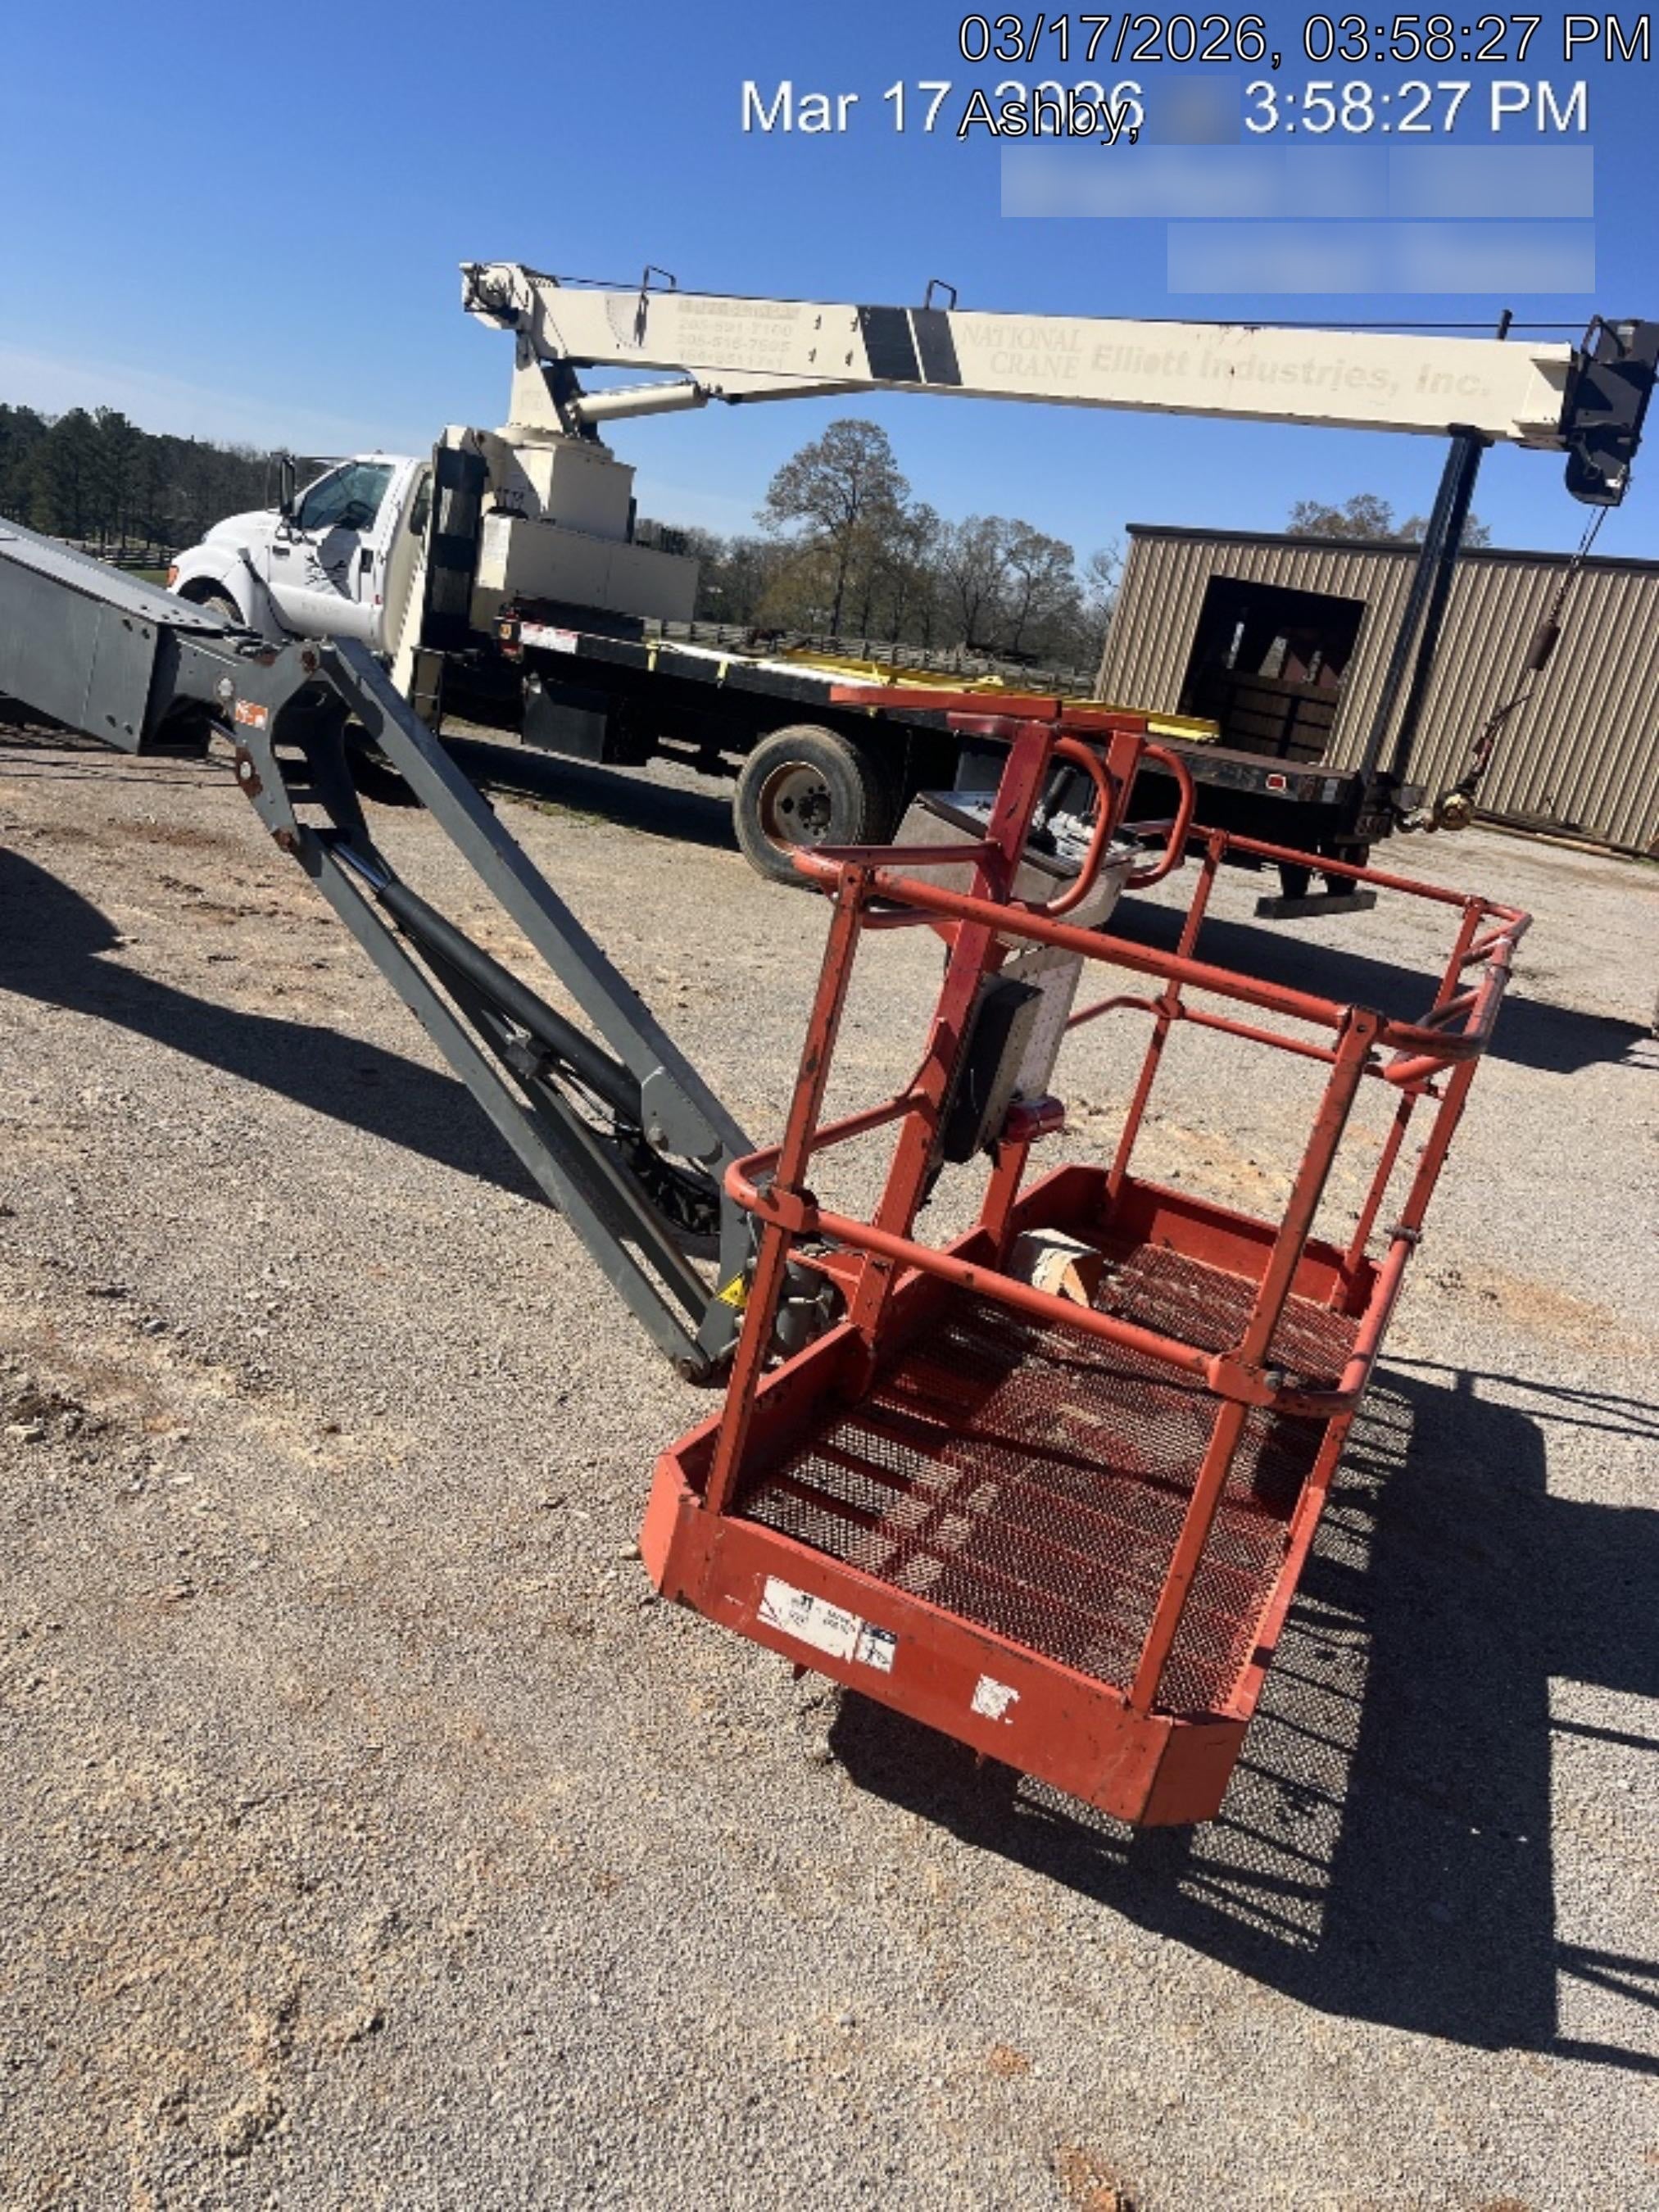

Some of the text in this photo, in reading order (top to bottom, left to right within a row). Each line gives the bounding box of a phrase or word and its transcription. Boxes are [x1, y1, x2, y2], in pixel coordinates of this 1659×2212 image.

[962, 321, 1082, 352] NATIONAL
[990, 351, 1080, 379] CRANE
[1090, 343, 1190, 378] Elliott
[1415, 363, 1493, 397] Inc.
